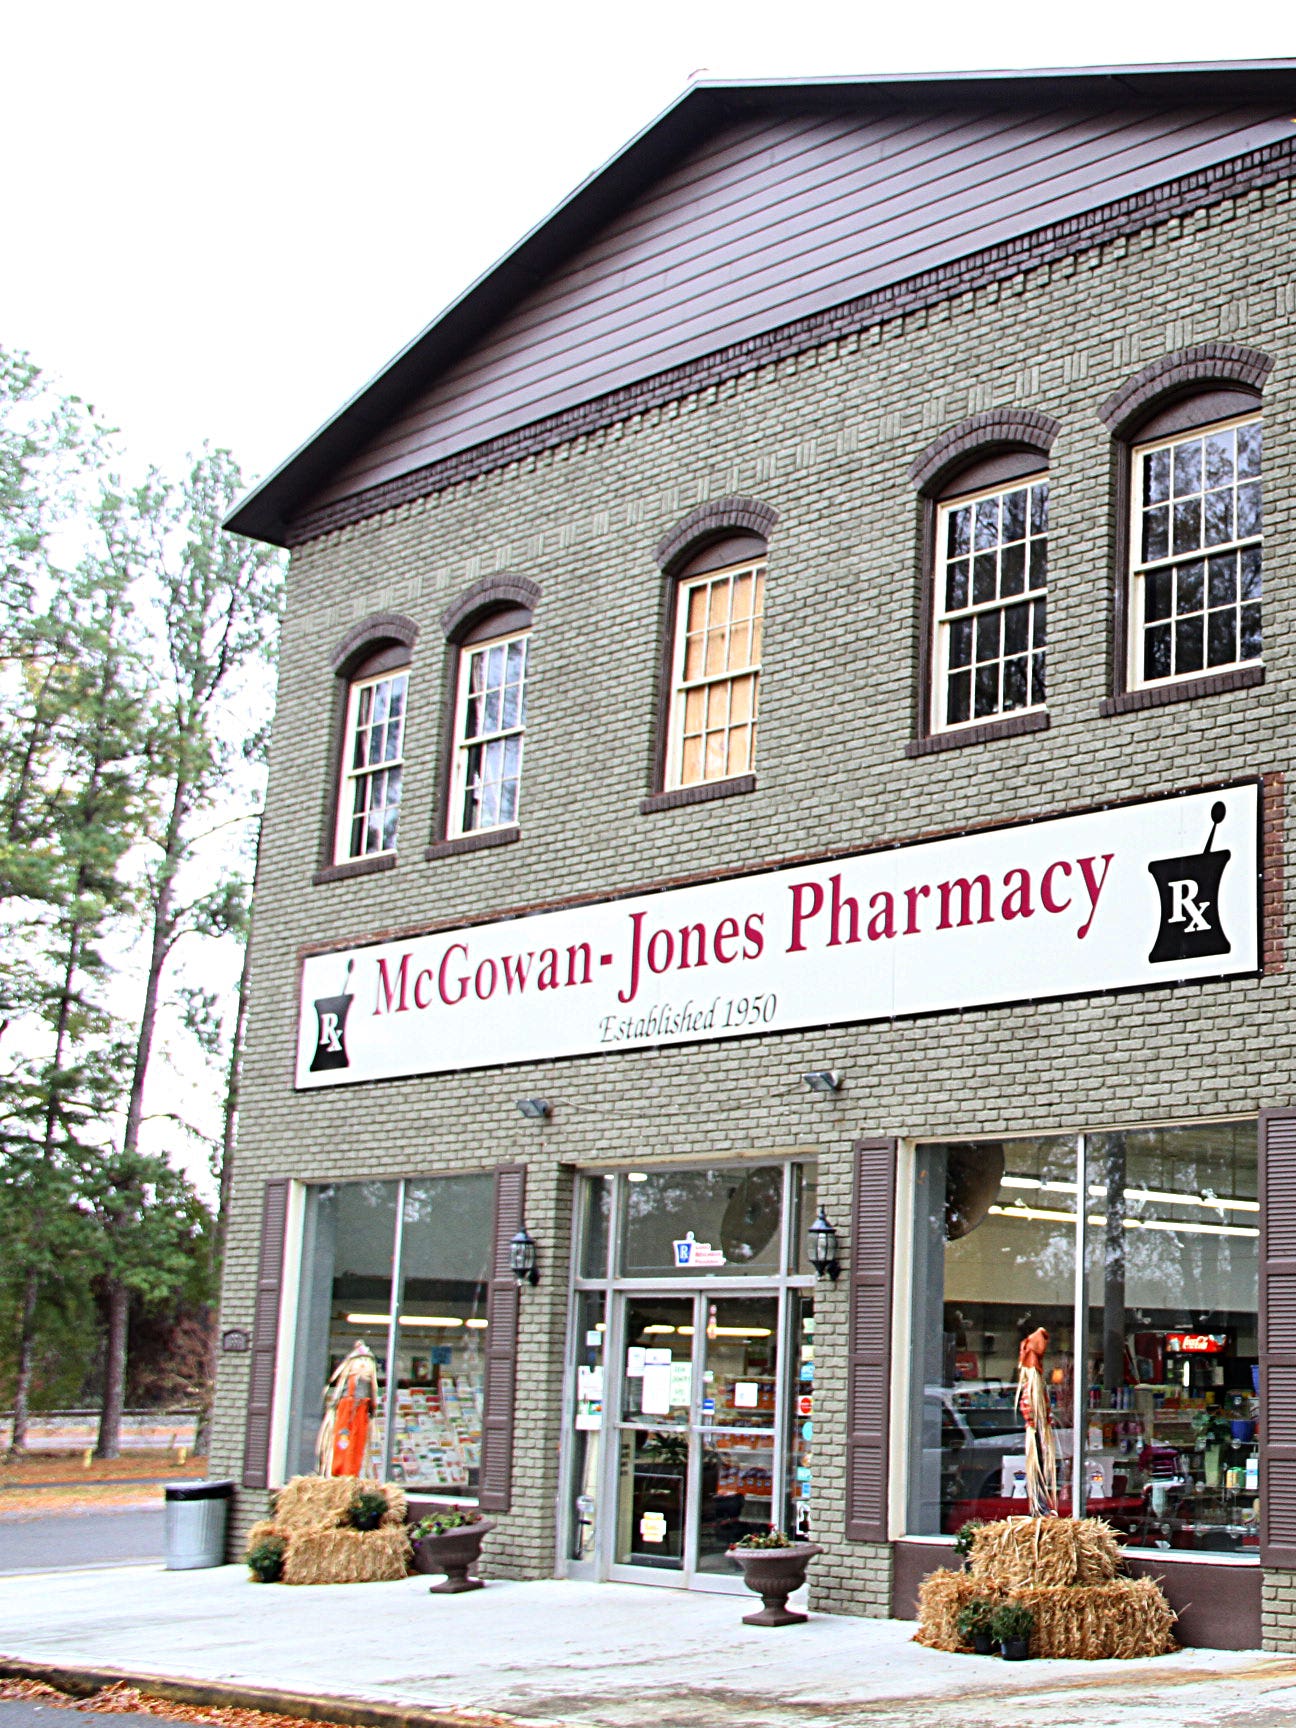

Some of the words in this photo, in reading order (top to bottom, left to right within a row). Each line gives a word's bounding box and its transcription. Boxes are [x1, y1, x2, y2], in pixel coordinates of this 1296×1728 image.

[1167, 878, 1212, 933] Rx
[372, 911, 765, 1016] McGowan-Jones
[785, 853, 1115, 952] Pharmacy
[599, 995, 718, 1044] Established
[721, 992, 777, 1028] 1950
